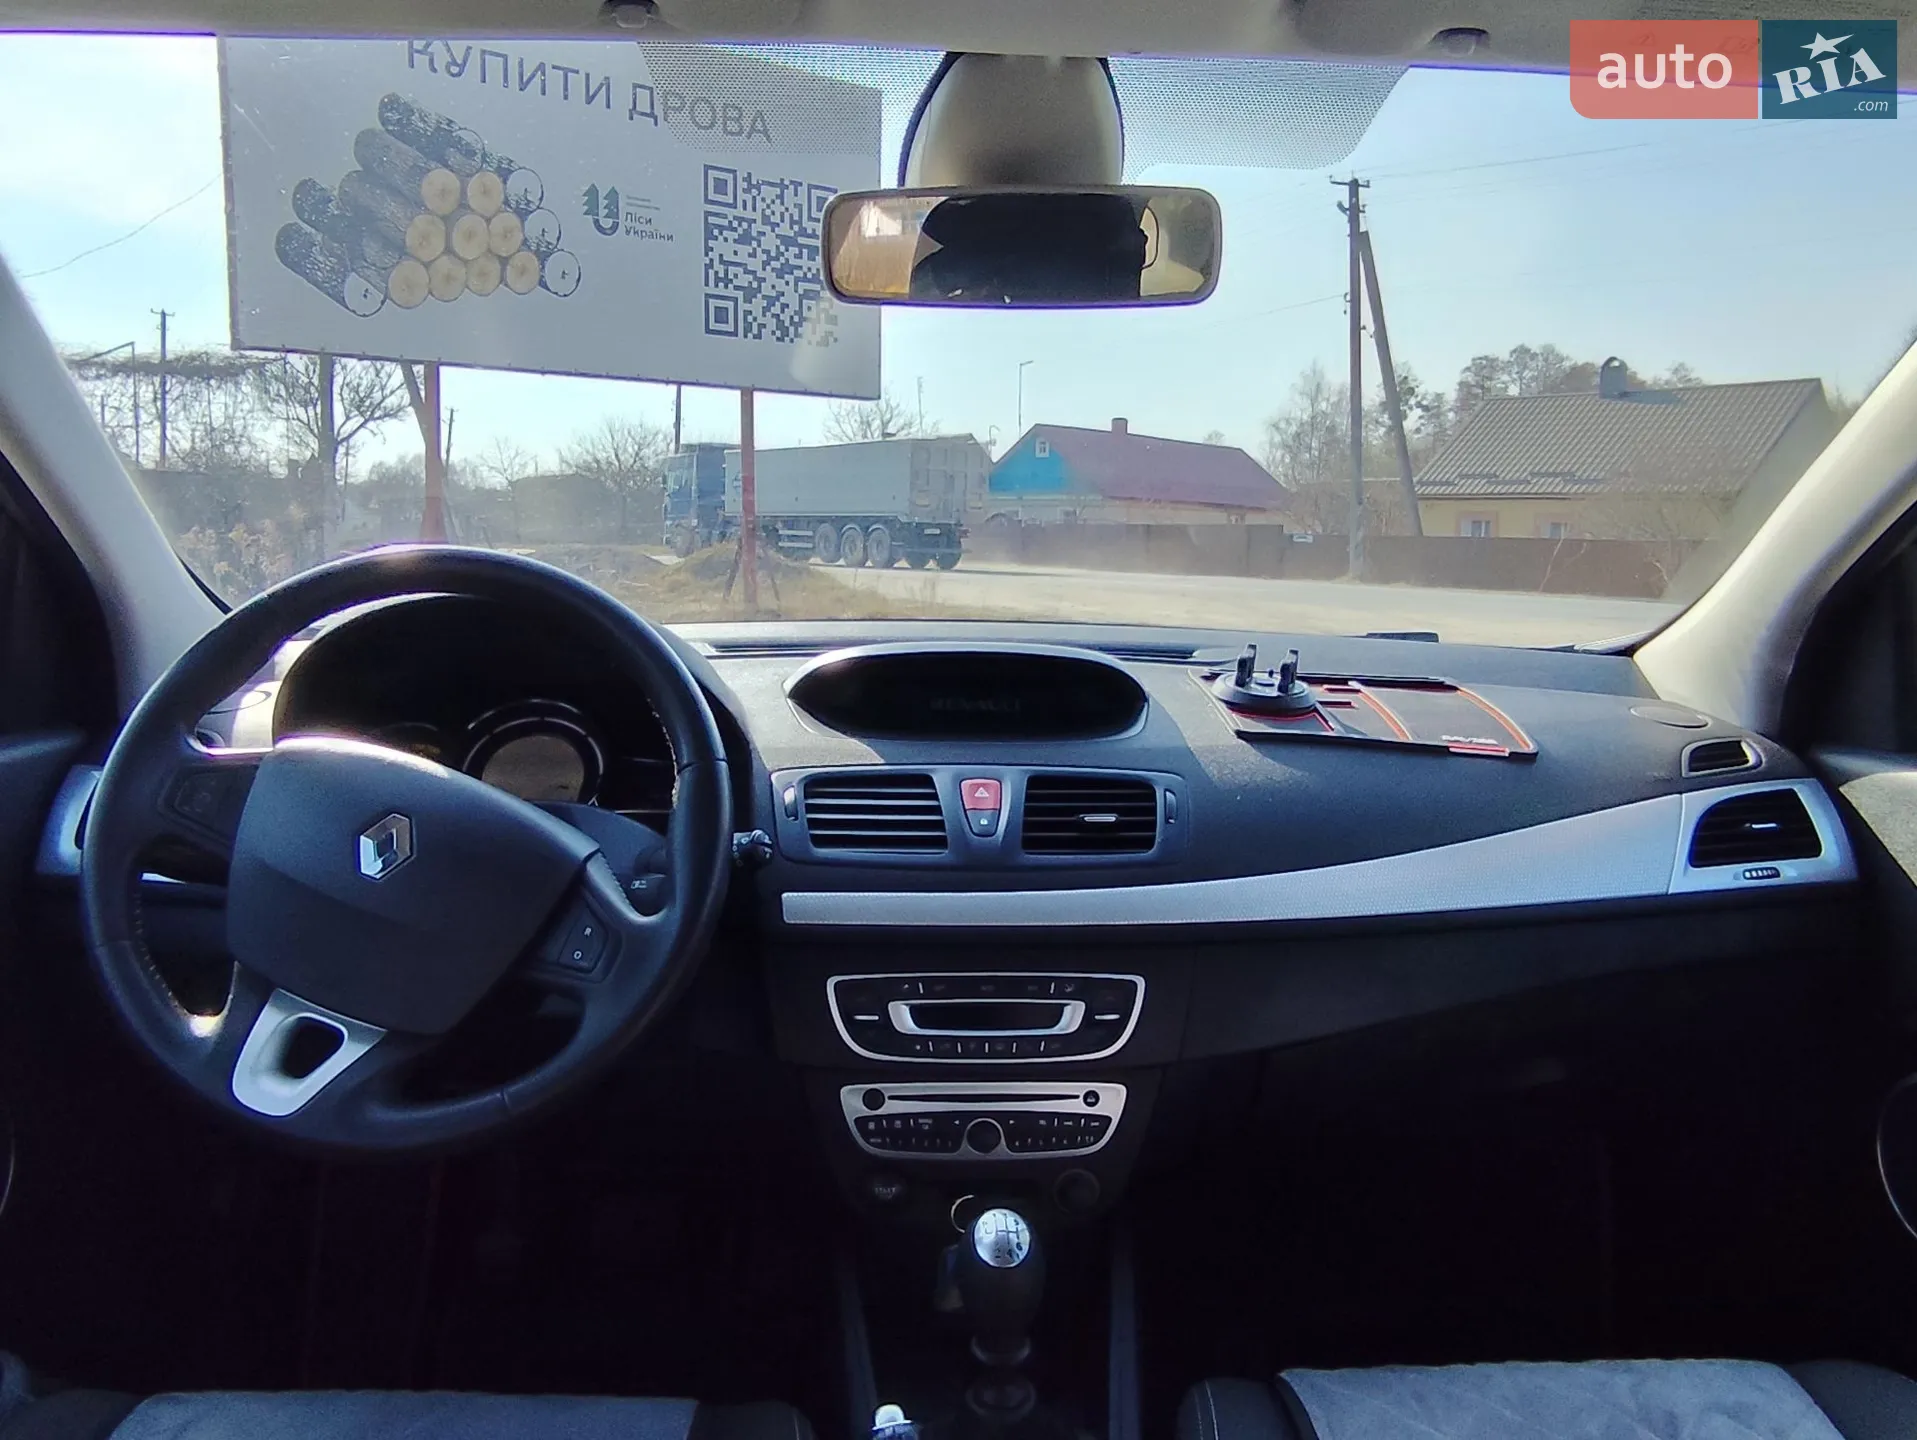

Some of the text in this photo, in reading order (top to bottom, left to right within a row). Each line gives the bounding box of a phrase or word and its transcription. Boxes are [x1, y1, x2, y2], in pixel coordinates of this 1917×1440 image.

[407, 40, 773, 146] КУПИТИ ДРОВА
[625, 211, 652, 226] Ліси
[624, 225, 674, 242] України
